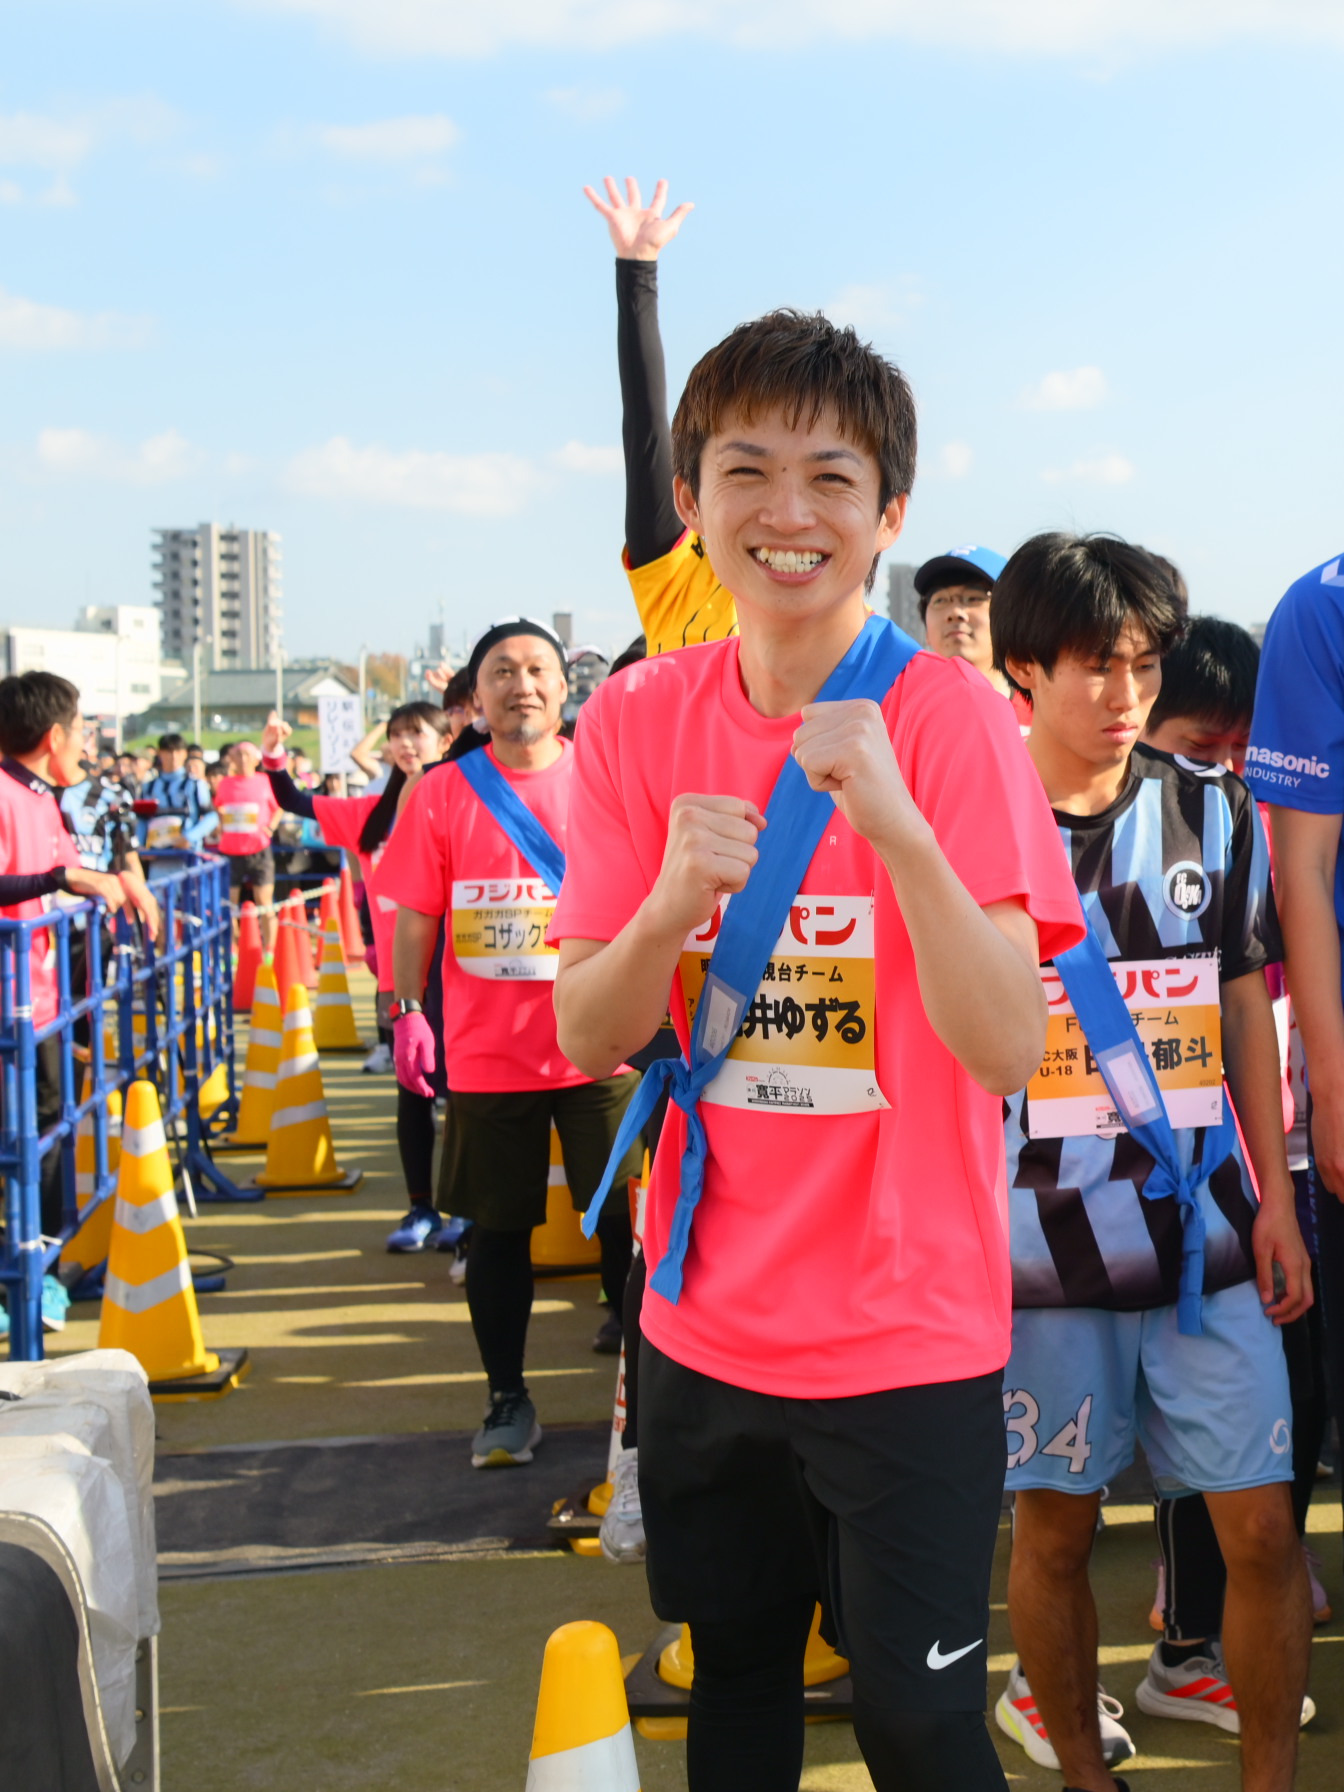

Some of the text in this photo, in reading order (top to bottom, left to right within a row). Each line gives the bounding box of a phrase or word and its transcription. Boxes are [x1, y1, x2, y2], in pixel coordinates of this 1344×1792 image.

[1245, 745, 1330, 778] nasonic
[484, 922, 549, 950] コザック
[695, 904, 857, 946] パン
[1041, 968, 1199, 1007] フパン
[736, 993, 866, 1045] 井ゆずる
[1066, 1010, 1180, 1033] Fチーム
[1039, 1065, 1073, 1078] U-18
[1084, 1035, 1213, 1076] 郁斗
[1002, 1388, 1094, 1474] 34
